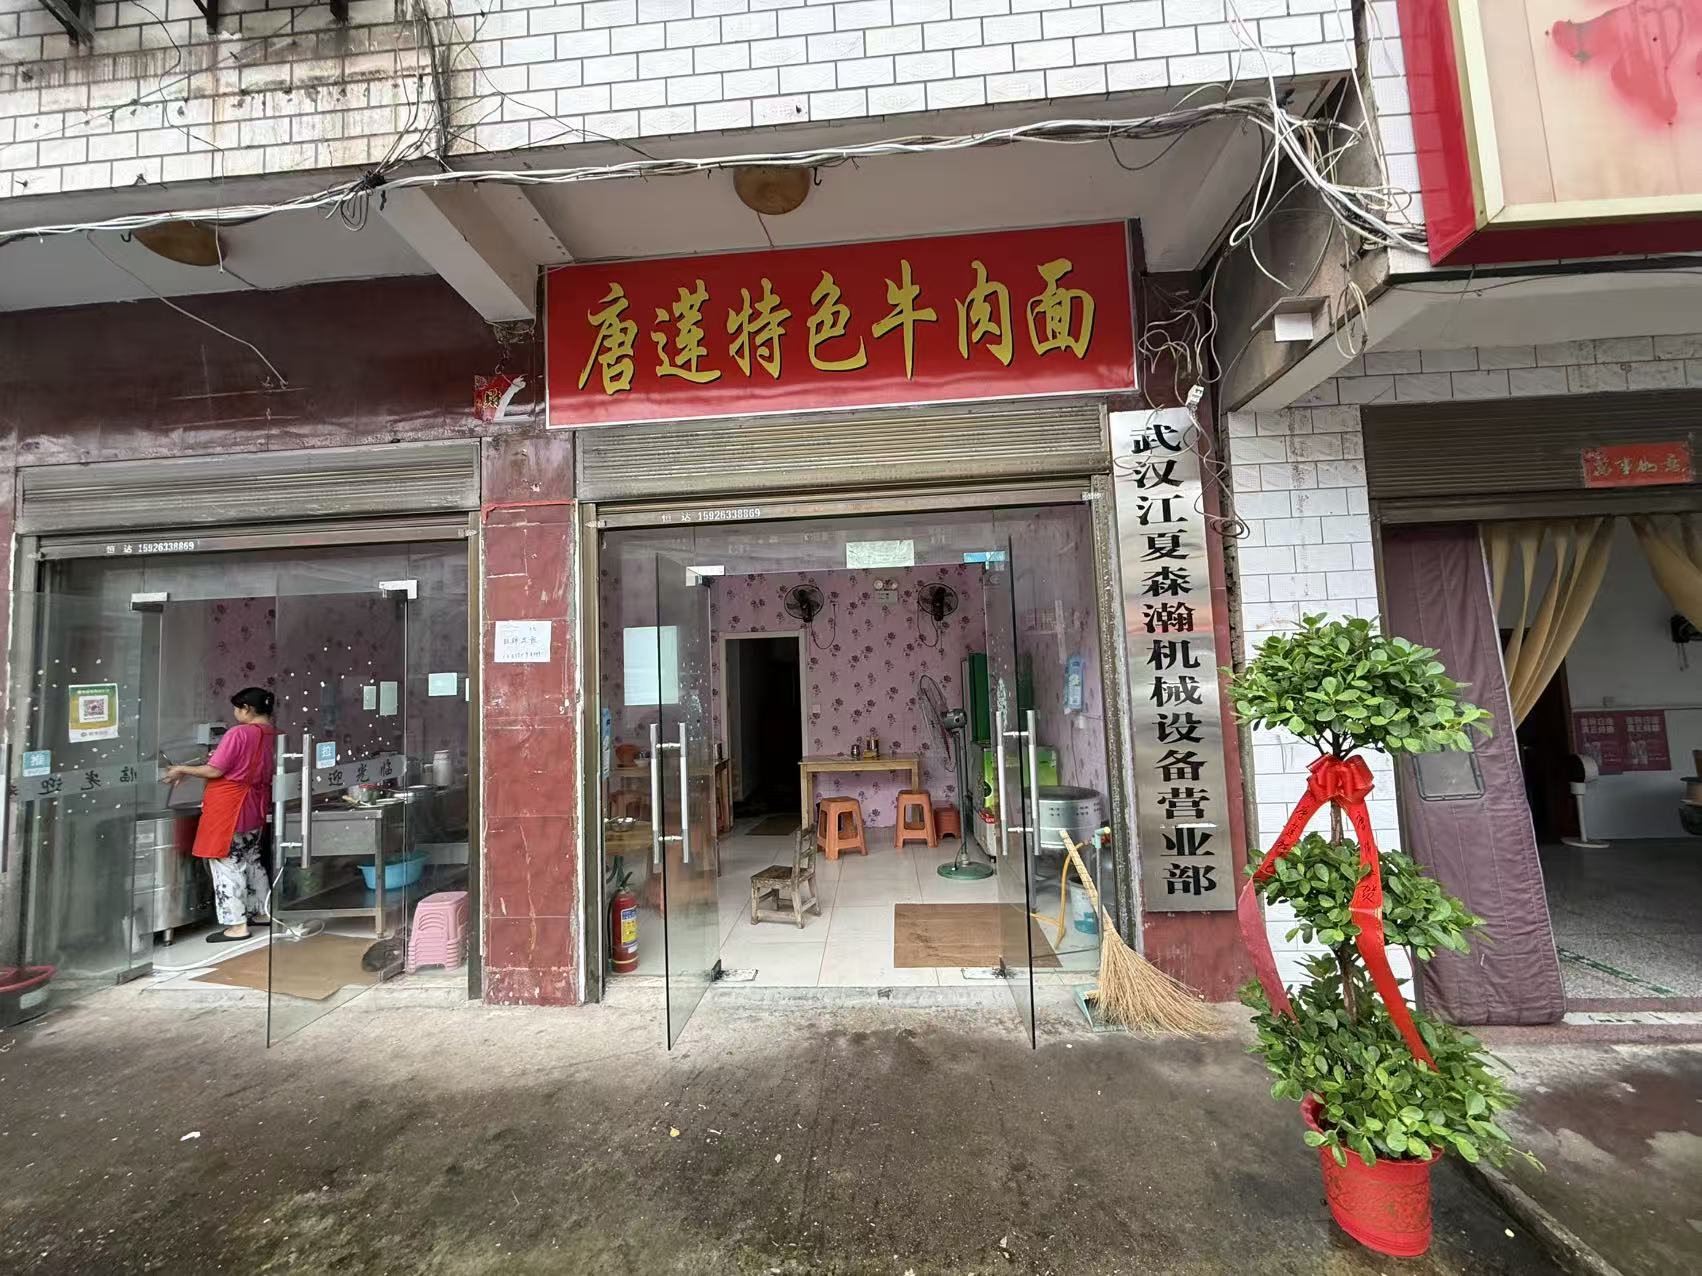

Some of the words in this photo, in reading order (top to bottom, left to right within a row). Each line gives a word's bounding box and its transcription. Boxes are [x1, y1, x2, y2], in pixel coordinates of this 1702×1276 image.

[697, 508, 761, 521] 15926338869
[138, 541, 195, 553] 15926338869
[1130, 422, 1217, 897] 武汉江夏森瀚机械设备营业部
